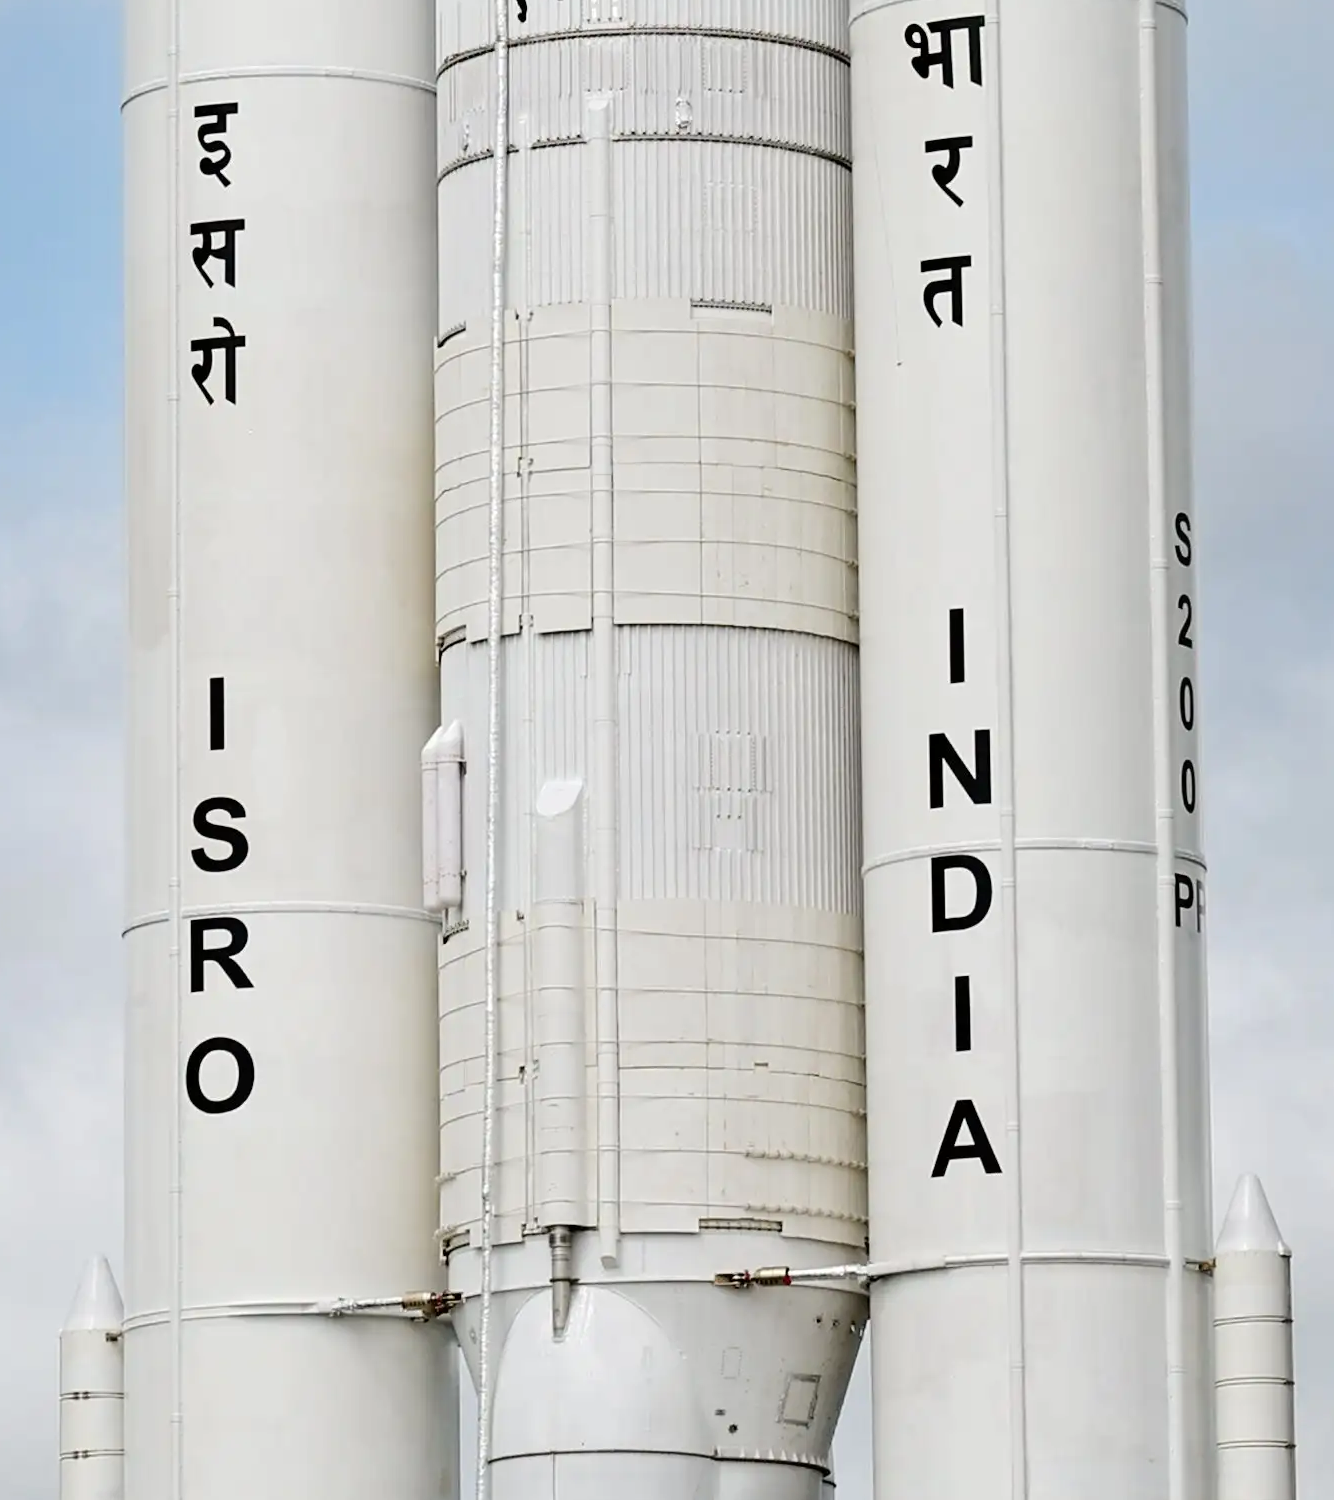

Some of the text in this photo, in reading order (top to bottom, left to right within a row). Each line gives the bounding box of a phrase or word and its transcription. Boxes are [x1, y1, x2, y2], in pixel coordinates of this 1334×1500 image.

[190, 101, 246, 406] इसरो
[904, 14, 986, 328] भारत
[185, 676, 255, 1115] ISRO
[928, 607, 1003, 1179] INDIA
